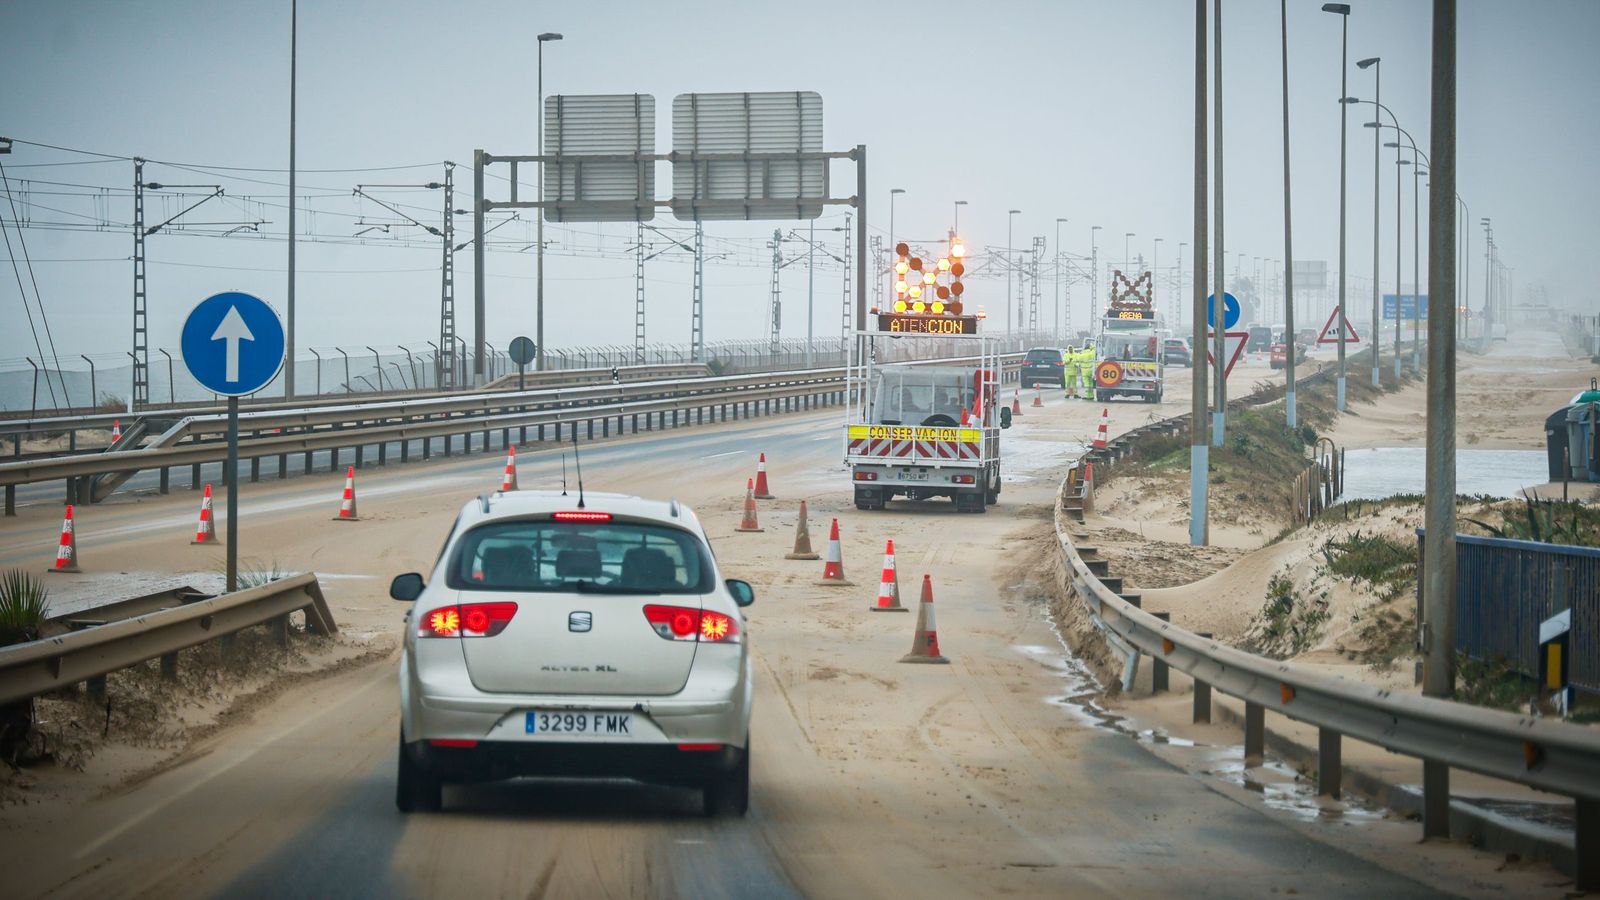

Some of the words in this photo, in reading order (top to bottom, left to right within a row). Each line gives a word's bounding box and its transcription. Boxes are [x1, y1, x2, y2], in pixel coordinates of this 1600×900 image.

[1119, 312, 1143, 320] ARENA
[890, 318, 963, 334] ATENCION
[1102, 369, 1117, 379] 80
[539, 714, 587, 732] 3299
[593, 714, 629, 734] FMK
